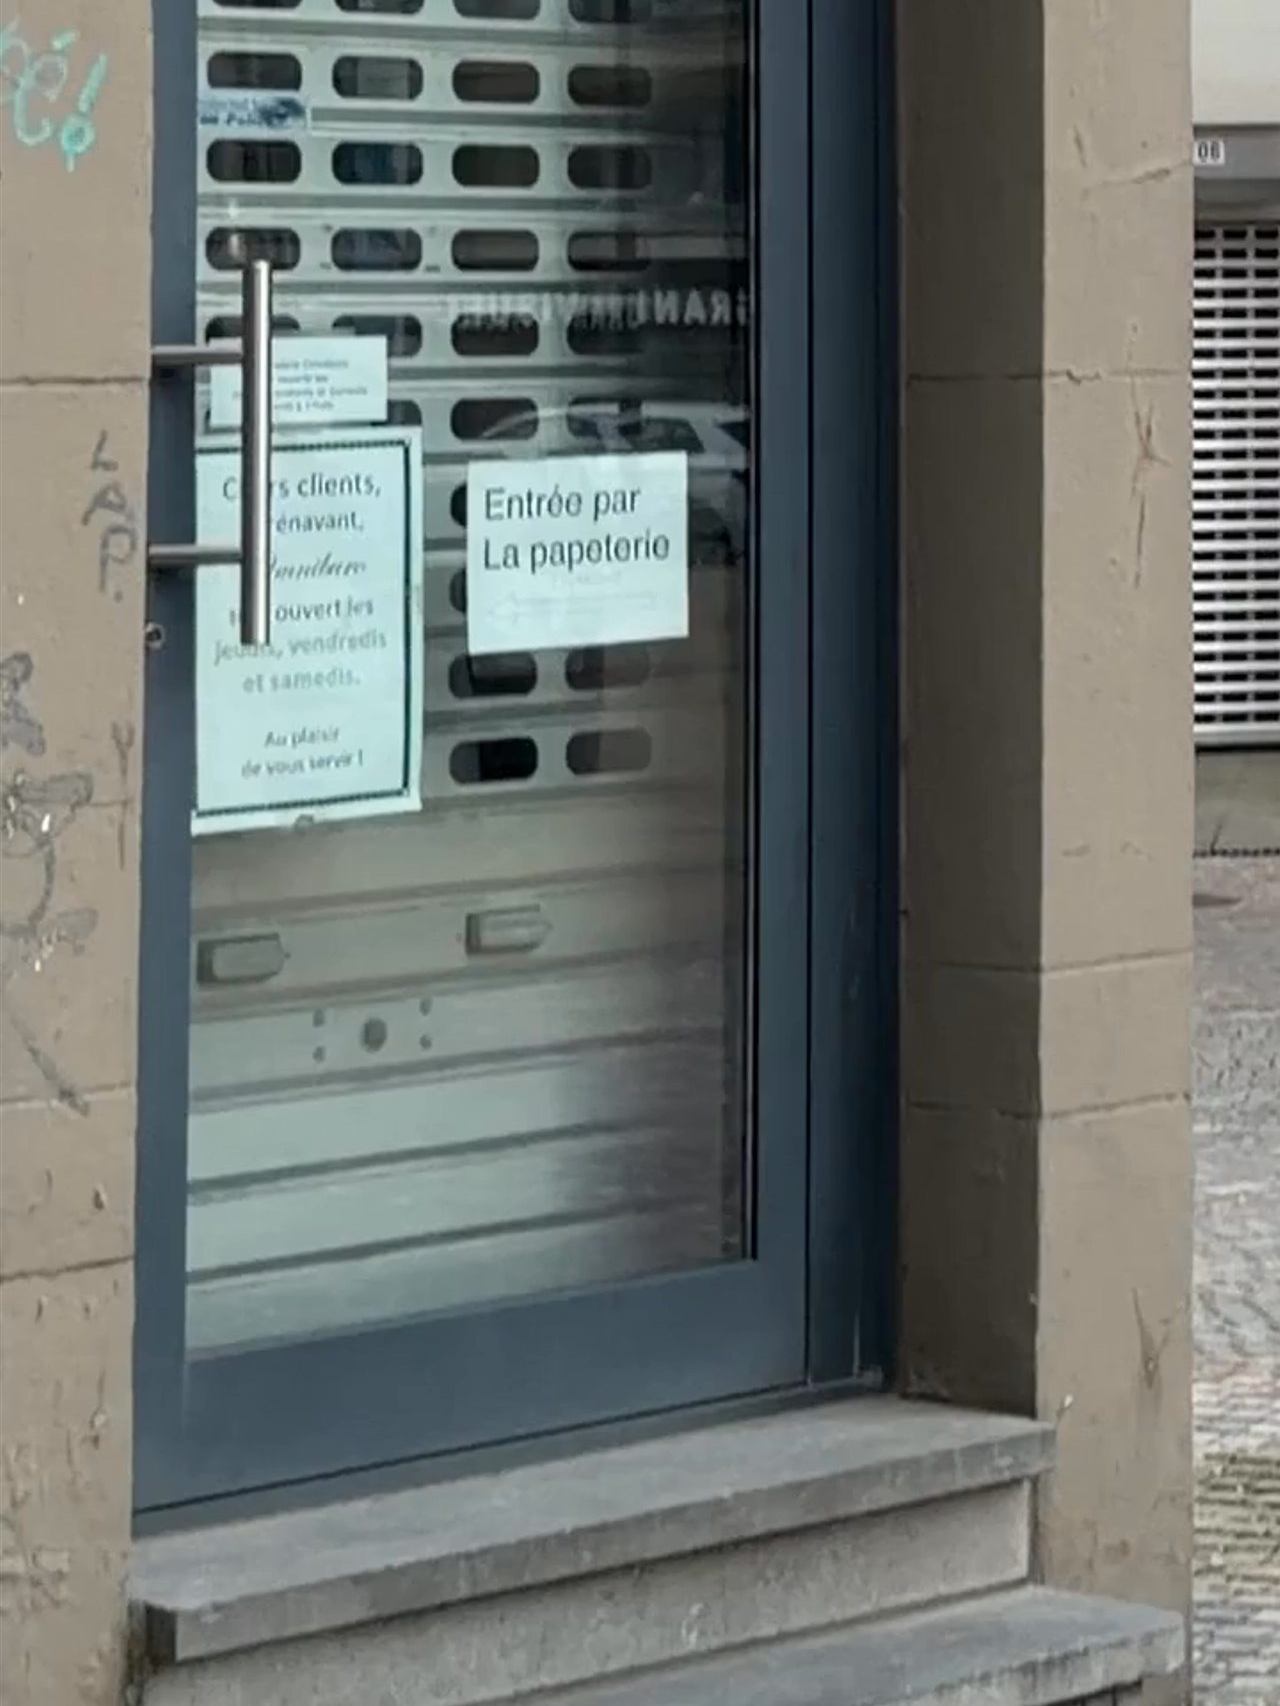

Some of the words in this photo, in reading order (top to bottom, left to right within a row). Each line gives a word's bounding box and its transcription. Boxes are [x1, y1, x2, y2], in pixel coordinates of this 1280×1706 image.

[484, 482, 583, 521] Entrée
[593, 487, 641, 525] par
[269, 511, 364, 535] énavant,
[483, 537, 520, 571] La
[530, 528, 671, 575] papeterie
[274, 599, 341, 622] ouvert
[287, 628, 388, 658] vendredis
[242, 673, 264, 694] et
